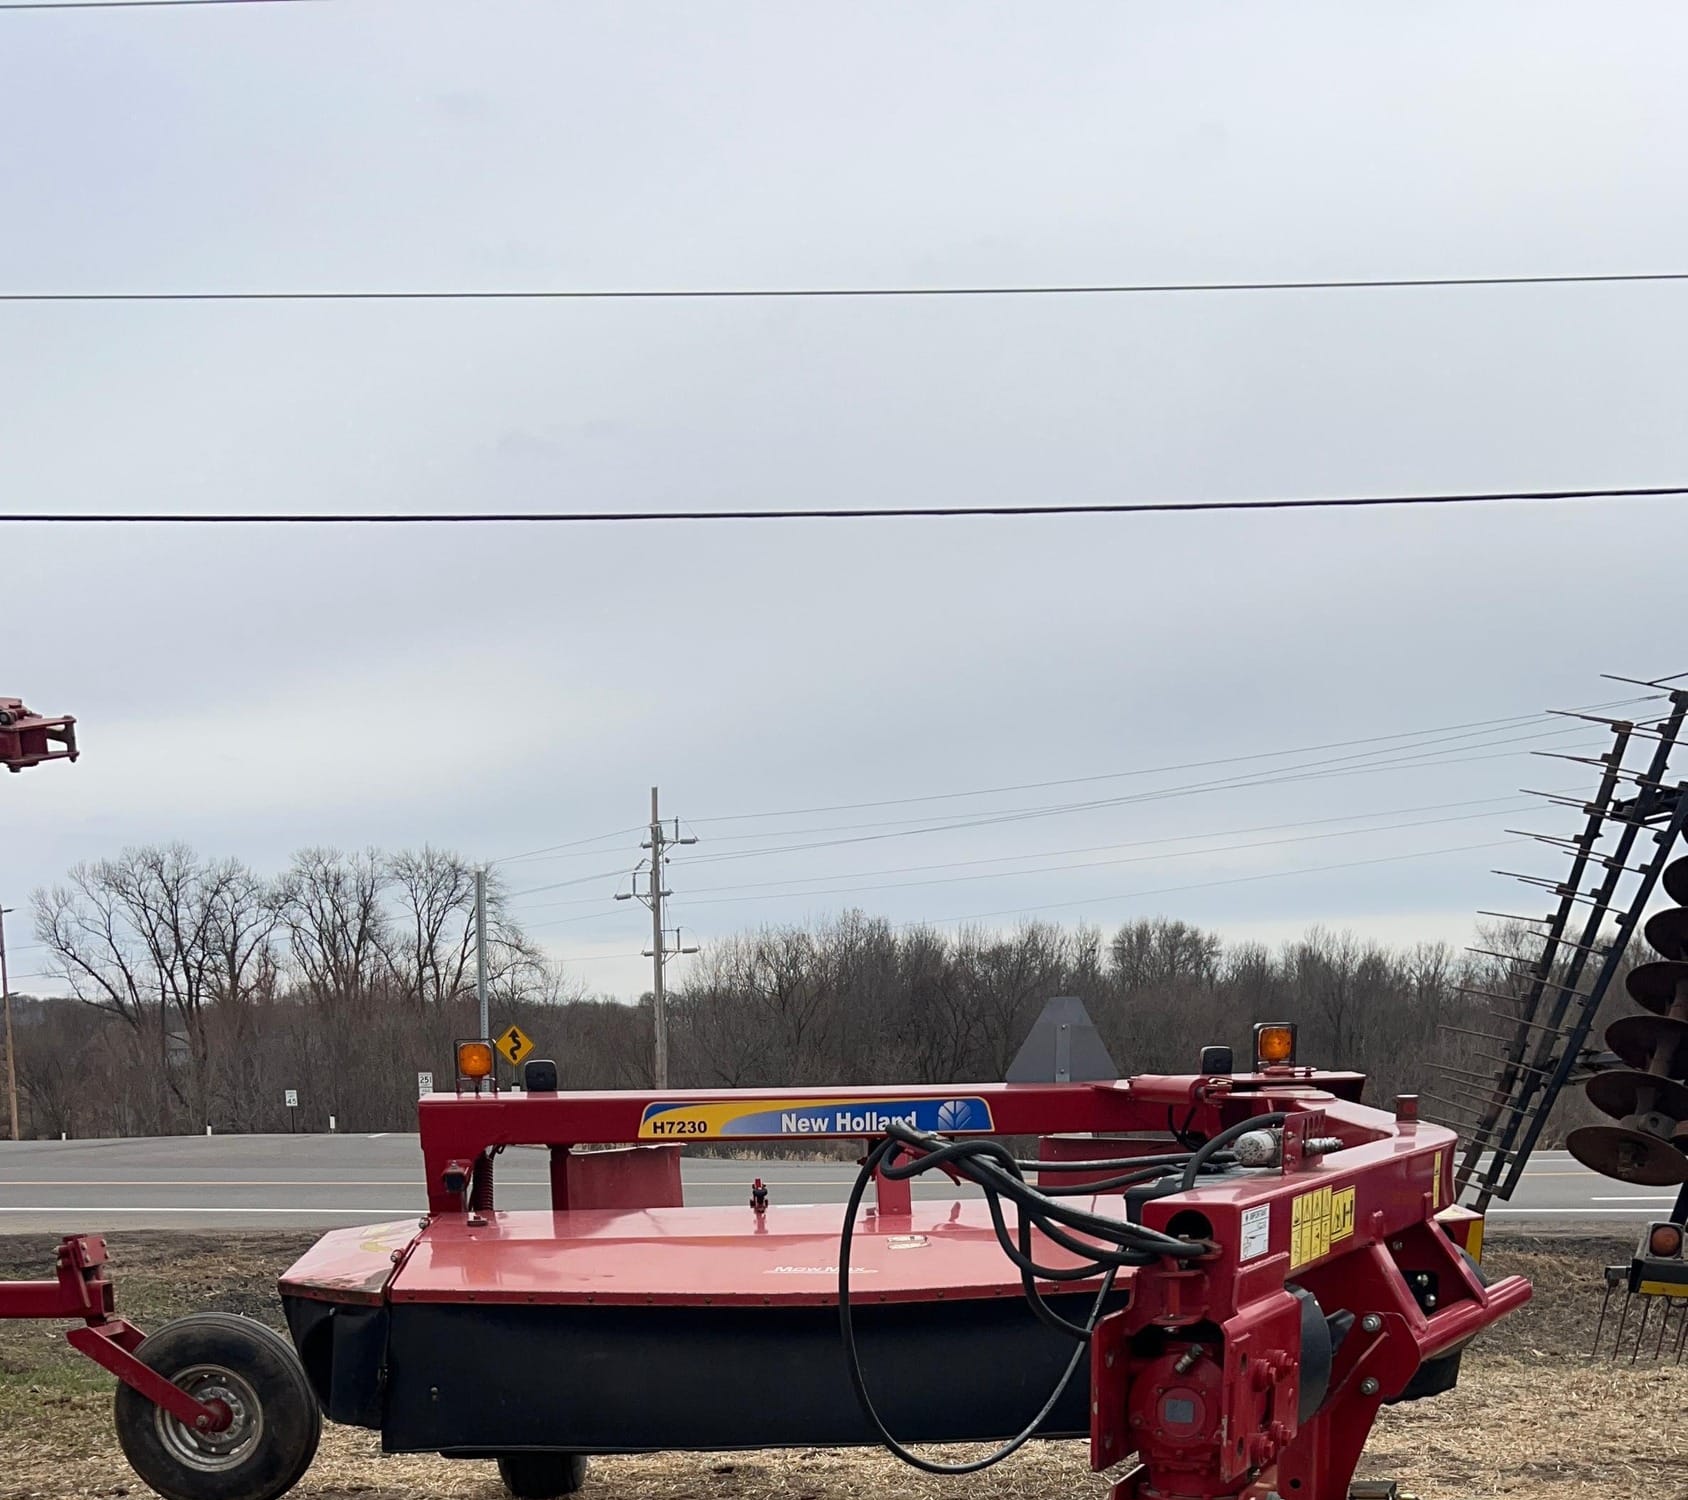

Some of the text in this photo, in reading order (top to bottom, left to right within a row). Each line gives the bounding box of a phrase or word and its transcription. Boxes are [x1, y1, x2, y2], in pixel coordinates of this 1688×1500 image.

[653, 1121, 707, 1134] H7230
[781, 1111, 917, 1133] New Holland
